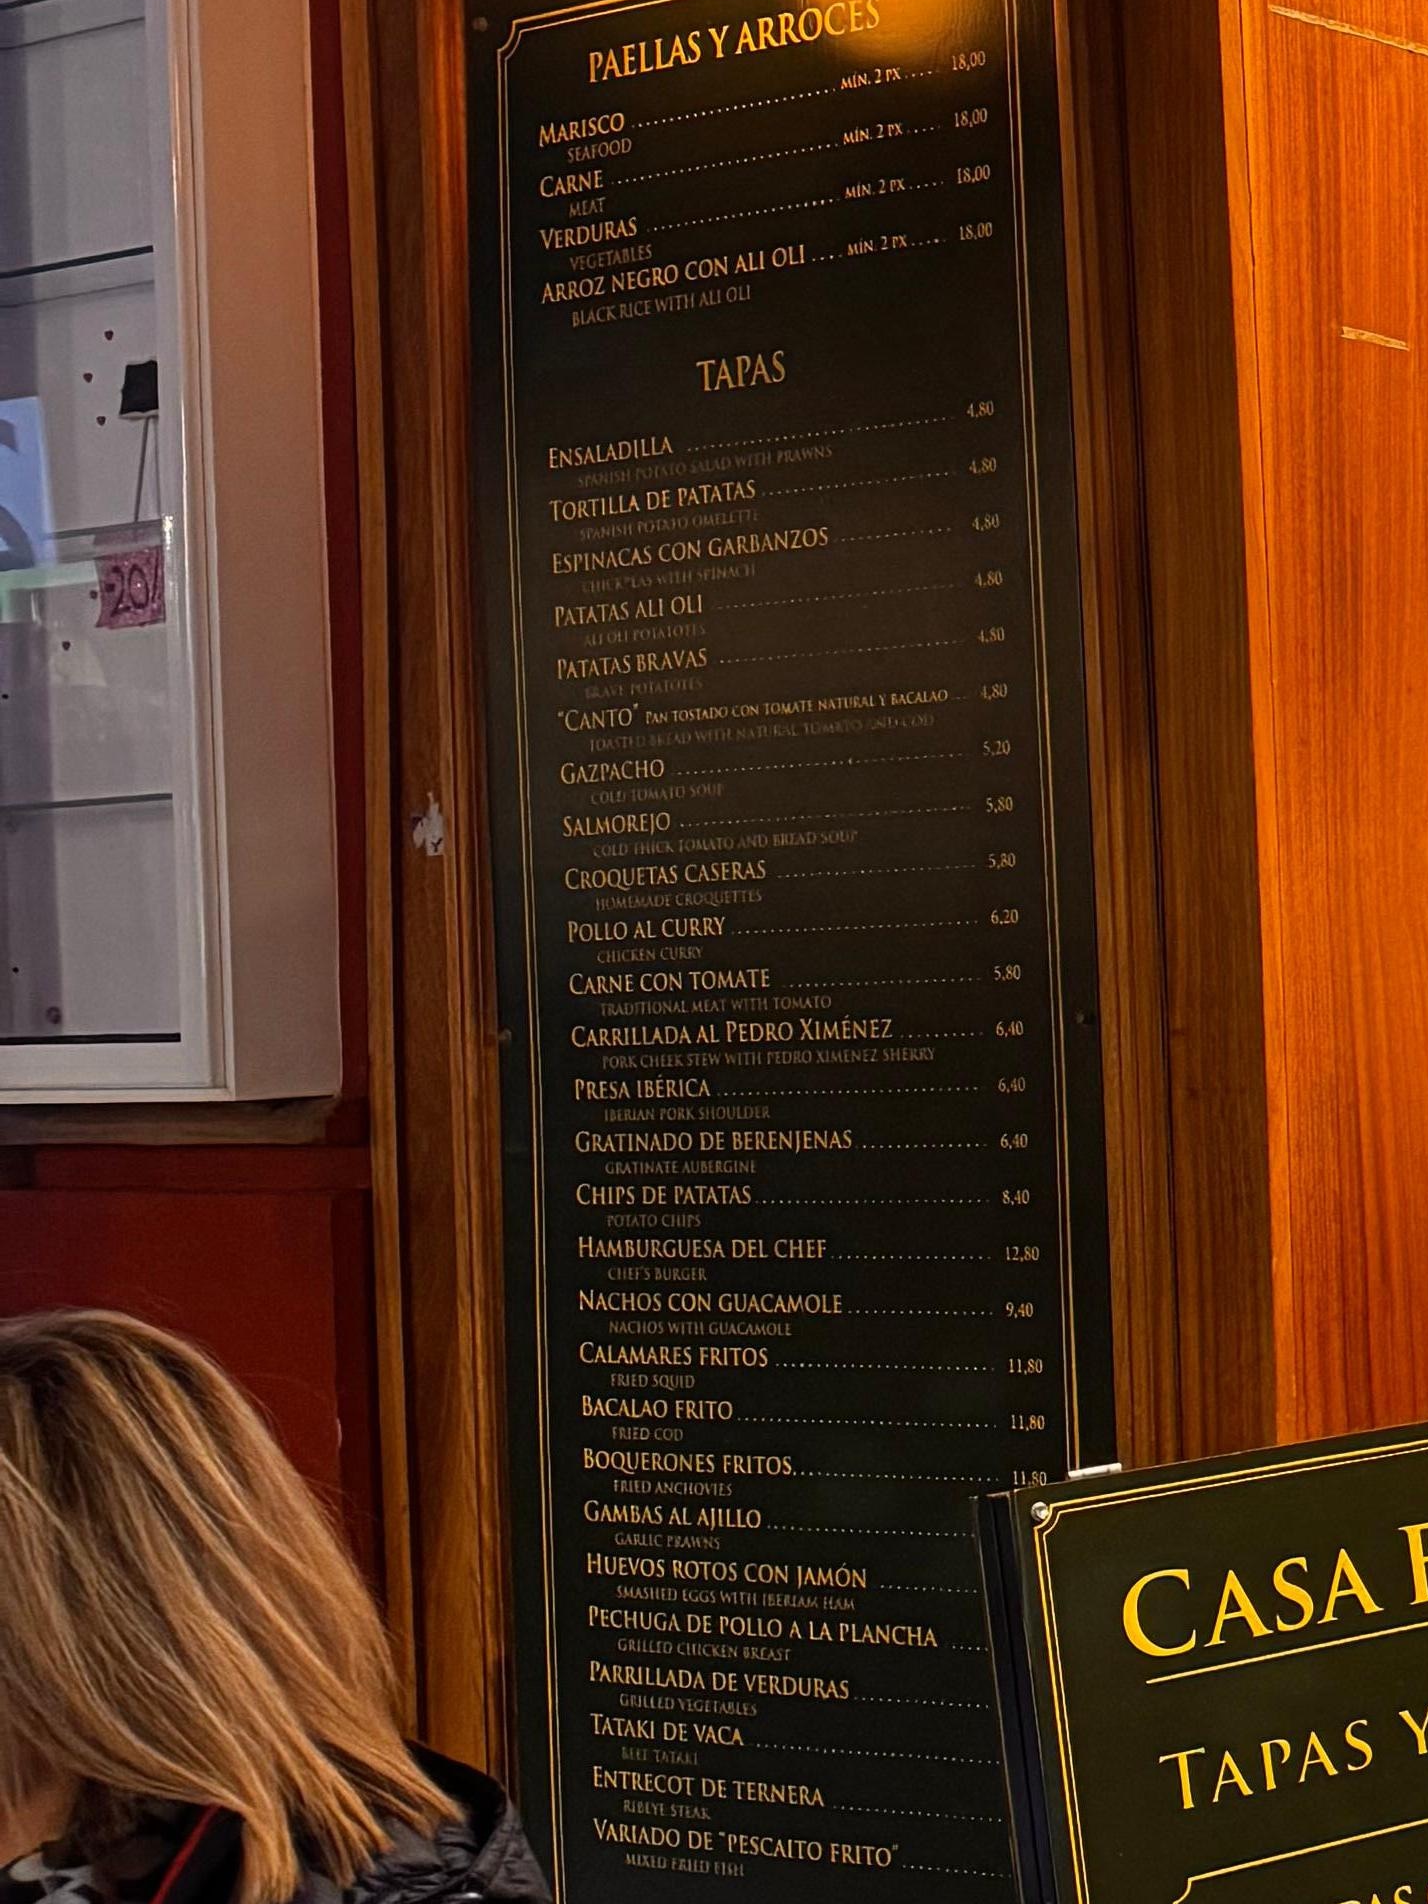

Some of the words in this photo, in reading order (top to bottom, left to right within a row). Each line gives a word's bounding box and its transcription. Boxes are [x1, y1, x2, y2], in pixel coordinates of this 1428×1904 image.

[590, 31, 701, 82] PAELLAS
[708, 25, 729, 58] Y
[540, 113, 624, 147] MARISCO
[540, 170, 603, 197] CARNE
[540, 217, 637, 249] VERDURAS
[542, 276, 604, 304] ARROZ
[612, 265, 678, 292] NEGRO
[685, 256, 727, 280] CON
[735, 251, 764, 273] ALI
[772, 245, 804, 267] OLI
[696, 351, 785, 391] TAPAS
[549, 437, 673, 468] ENSALADILLA
[549, 495, 640, 521] TORTILLA
[647, 490, 670, 510] DE
[678, 480, 755, 506] PATATAS
[553, 547, 652, 573] ESPINACAS
[658, 540, 700, 562] CON
[708, 527, 828, 556] GARBANZOS
[555, 602, 629, 627] PATATAS
[636, 598, 663, 618] ALI
[671, 594, 702, 614] OLI
[558, 655, 630, 679] PATATAS
[637, 648, 707, 672] BRAVAS
[879, 695, 885, 706] Y
[561, 759, 664, 784] GAZPACHO
[563, 812, 670, 837] SALMOREJO
[565, 865, 677, 891] CROQUETAS
[685, 860, 766, 882] CASERAS
[568, 921, 627, 942] POLLO
[634, 920, 656, 938] AL
[662, 917, 725, 937] CURRY
[570, 973, 633, 994] CARNE
[640, 972, 682, 991] CON
[689, 969, 769, 990] TOMATE
[572, 1026, 691, 1047] CARRILLADA
[696, 1024, 719, 1043] AL
[726, 1021, 793, 1042] PEDRO
[800, 1015, 892, 1040] XIMÉNEZ
[575, 1079, 630, 1100] PRESA
[637, 1075, 710, 1098] IBÉRICA
[575, 1131, 692, 1152] GRATINADO
[700, 1132, 724, 1150] DE
[732, 1130, 851, 1153] BERENJENAS
[576, 1184, 634, 1205] CHIPS
[642, 1186, 666, 1204] DE
[675, 1186, 751, 1204] PATATAS
[579, 1236, 725, 1258] HAMBURGUESA
[732, 1240, 768, 1258] DEL
[774, 1240, 826, 1258] CHEF
[580, 1290, 661, 1311] NACHOS
[668, 1293, 710, 1312] CON
[719, 1294, 842, 1313] GUACAMOLE
[580, 1342, 691, 1365] CALAMARES
[700, 1347, 768, 1367] FRITOS
[583, 1395, 667, 1418] BACALAO
[676, 1400, 732, 1419] FRITO
[584, 1448, 714, 1474] BOQUERONES
[724, 1455, 792, 1475] FRITOS
[584, 1500, 662, 1524] GAMBAS
[669, 1508, 691, 1525] AL
[697, 1508, 761, 1530] AJILLO
[588, 1553, 664, 1577] HUEVOS
[673, 1560, 737, 1581] ROTOS
[744, 1563, 788, 1583] CON
[798, 1563, 866, 1588] JAMÓN
[1123, 1549, 1384, 1656] CASA
[589, 1606, 680, 1631] PECHUGA
[688, 1614, 711, 1633] DE
[720, 1616, 782, 1637] POLLO
[790, 1621, 801, 1639] A
[810, 1621, 832, 1641] LA
[840, 1623, 937, 1647] PLANCHA
[590, 1661, 705, 1689] PARRILLADA
[713, 1672, 737, 1691] DE
[744, 1674, 848, 1699] VERDURAS
[590, 1713, 654, 1739] TATAKI
[664, 1722, 687, 1741] DE
[693, 1724, 744, 1746] VACA
[1159, 1720, 1372, 1809] TAPAS
[593, 1766, 694, 1795] ENTRECOT
[702, 1778, 726, 1798] DE
[733, 1781, 824, 1807] TERNERA
[594, 1818, 680, 1847] VARIADO
[688, 1831, 713, 1850] DE
